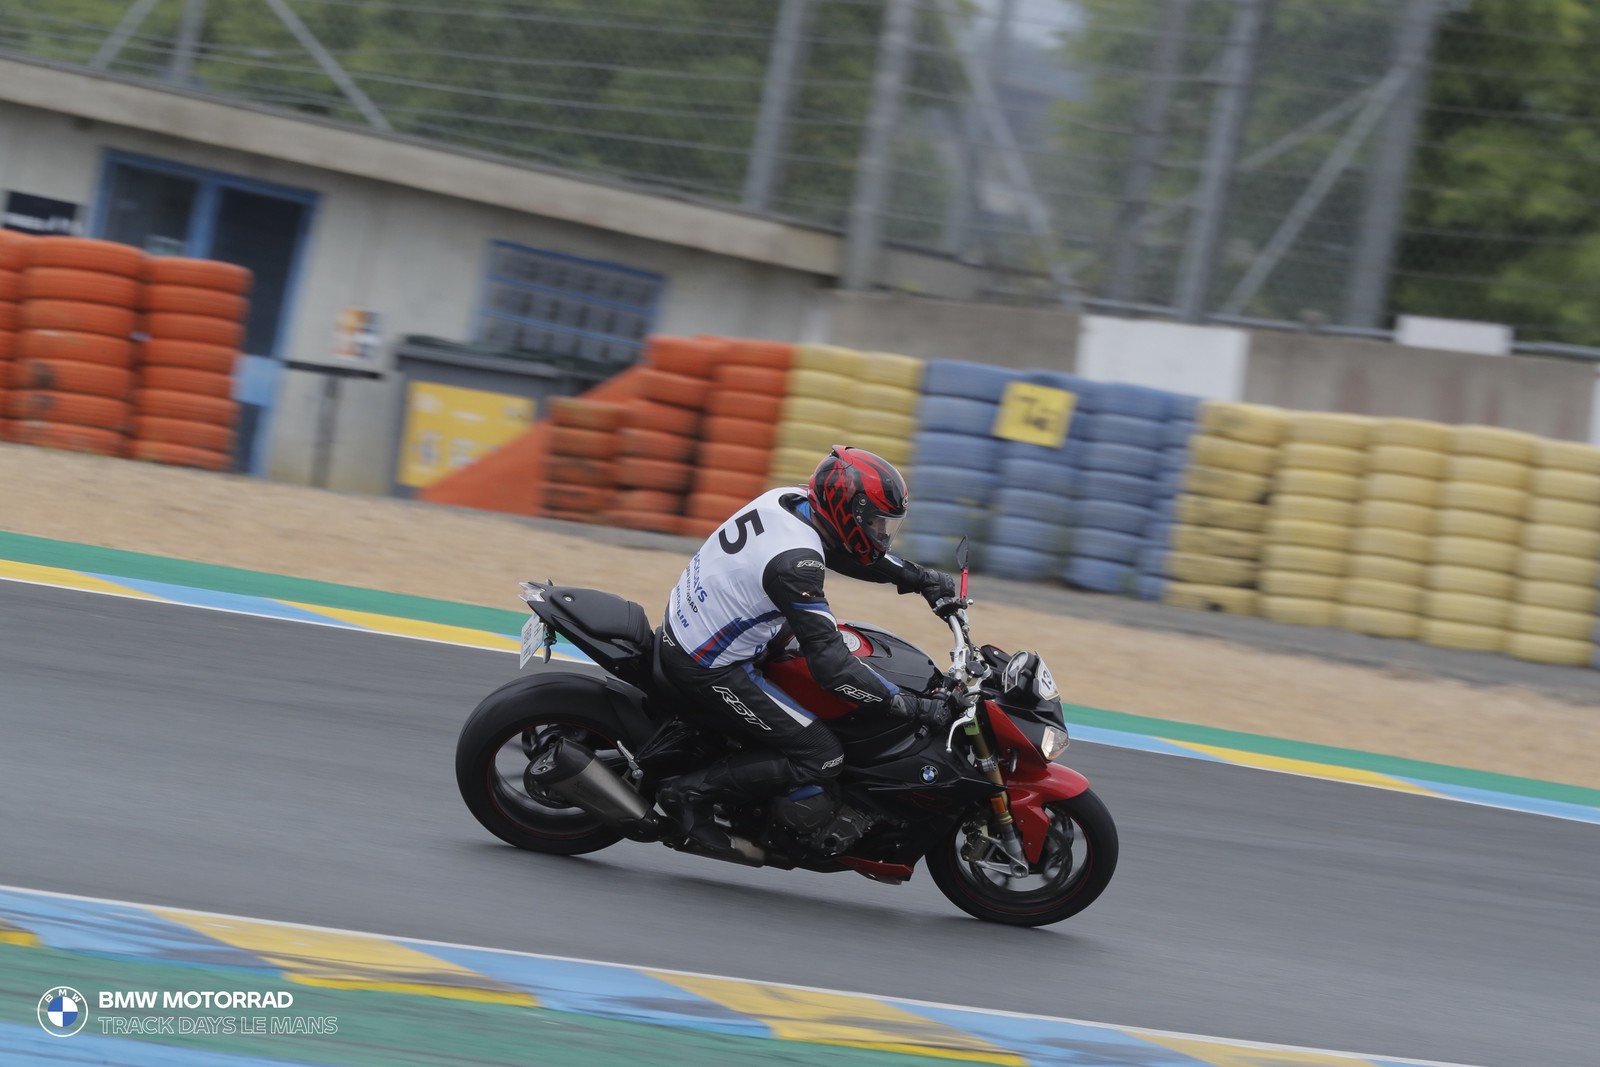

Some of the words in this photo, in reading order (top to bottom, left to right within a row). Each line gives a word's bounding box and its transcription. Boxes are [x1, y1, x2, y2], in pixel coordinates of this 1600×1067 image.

[718, 508, 765, 555] 5
[711, 685, 773, 731] RST
[834, 683, 884, 703] RST
